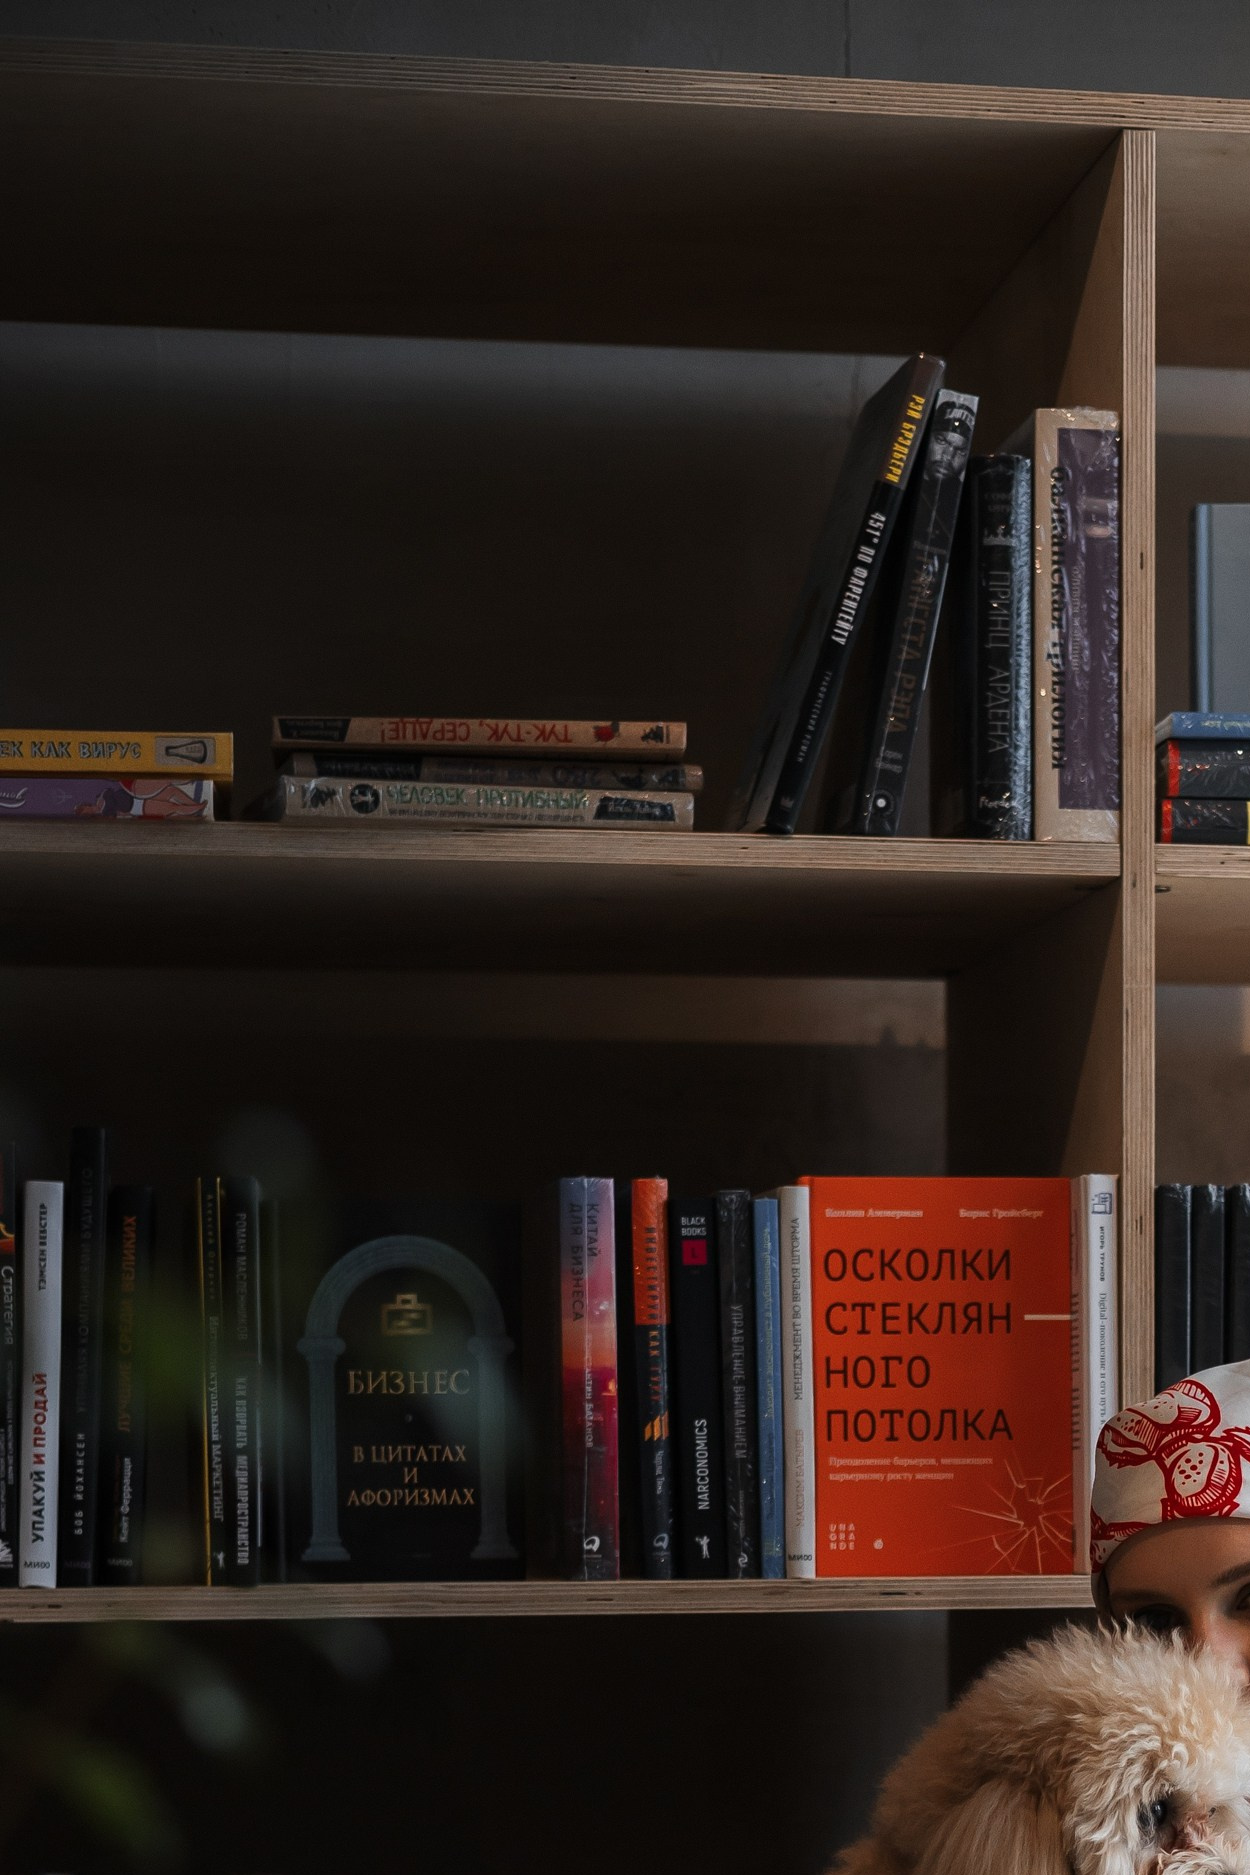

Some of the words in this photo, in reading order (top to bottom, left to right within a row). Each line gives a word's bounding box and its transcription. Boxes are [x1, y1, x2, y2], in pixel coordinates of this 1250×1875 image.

[905, 393, 926, 420] РЭЙ
[885, 421, 917, 483] БРЭДБЕРИ
[857, 545, 875, 563] ПО
[830, 566, 868, 647] ФАРЕНГЕЙТУ
[985, 570, 1011, 650] ПРИНЦ
[985, 665, 1010, 753] АРДЕНА
[381, 717, 470, 743] СЕРДЦЕ!
[480, 719, 573, 744] ТУК-ТУК,
[31, 741, 71, 758] КАК
[79, 742, 141, 759] ВИРУС
[386, 786, 466, 806] ЧЕЛОВЕК
[476, 788, 590, 811] ПРОТИВНЫЙ
[236, 1212, 249, 1252] РОМАН
[569, 1203, 584, 1236] ДЛЯ
[587, 1203, 601, 1257] КИТАЙ
[681, 1216, 706, 1226] BLACK
[681, 1227, 707, 1237] BOOKS
[120, 1215, 137, 1294] ВЕЛИКИХ
[791, 1218, 801, 1265] ШТОРМА
[824, 1249, 1011, 1281] ОСКОЛКИ
[570, 1245, 584, 1321] БИЗНЕСА
[793, 1268, 802, 1302] ВРЕМЯ
[1, 1265, 15, 1345] Стратегия
[794, 1303, 802, 1319] ВО
[825, 1302, 1012, 1335] СТЕКЛЯН
[732, 1304, 746, 1380] УПРАВЛЕНИЕ
[793, 1322, 803, 1401] МЕНЕДЖМЕНТ
[826, 1356, 931, 1388] НОГО
[347, 1369, 470, 1396] БИЗНЕС
[32, 1372, 48, 1449] ПРОДАЙ
[236, 1399, 249, 1449] ВЗОРВАТЬ
[733, 1386, 748, 1459] ВНИМАНИЕМ
[827, 1409, 1014, 1442] ПОТОЛКА
[33, 1453, 45, 1465] И
[72, 1432, 86, 1502] ЙОХАНСЕН
[353, 1446, 364, 1463] В
[371, 1445, 467, 1464] ЦИТАТАХ
[694, 1419, 711, 1512] NARCONOMICS
[212, 1444, 225, 1524] МАРКЕТИНГ
[403, 1467, 418, 1484] И
[30, 1470, 46, 1544] УПАКУЙ
[236, 1455, 250, 1567] МЕДИАПРОСТРАНСТВО
[347, 1489, 475, 1506] АФОРИЗМАХ
[73, 1509, 84, 1537] БОБ
[830, 1523, 855, 1532] UNA
[830, 1542, 855, 1550] NDE
